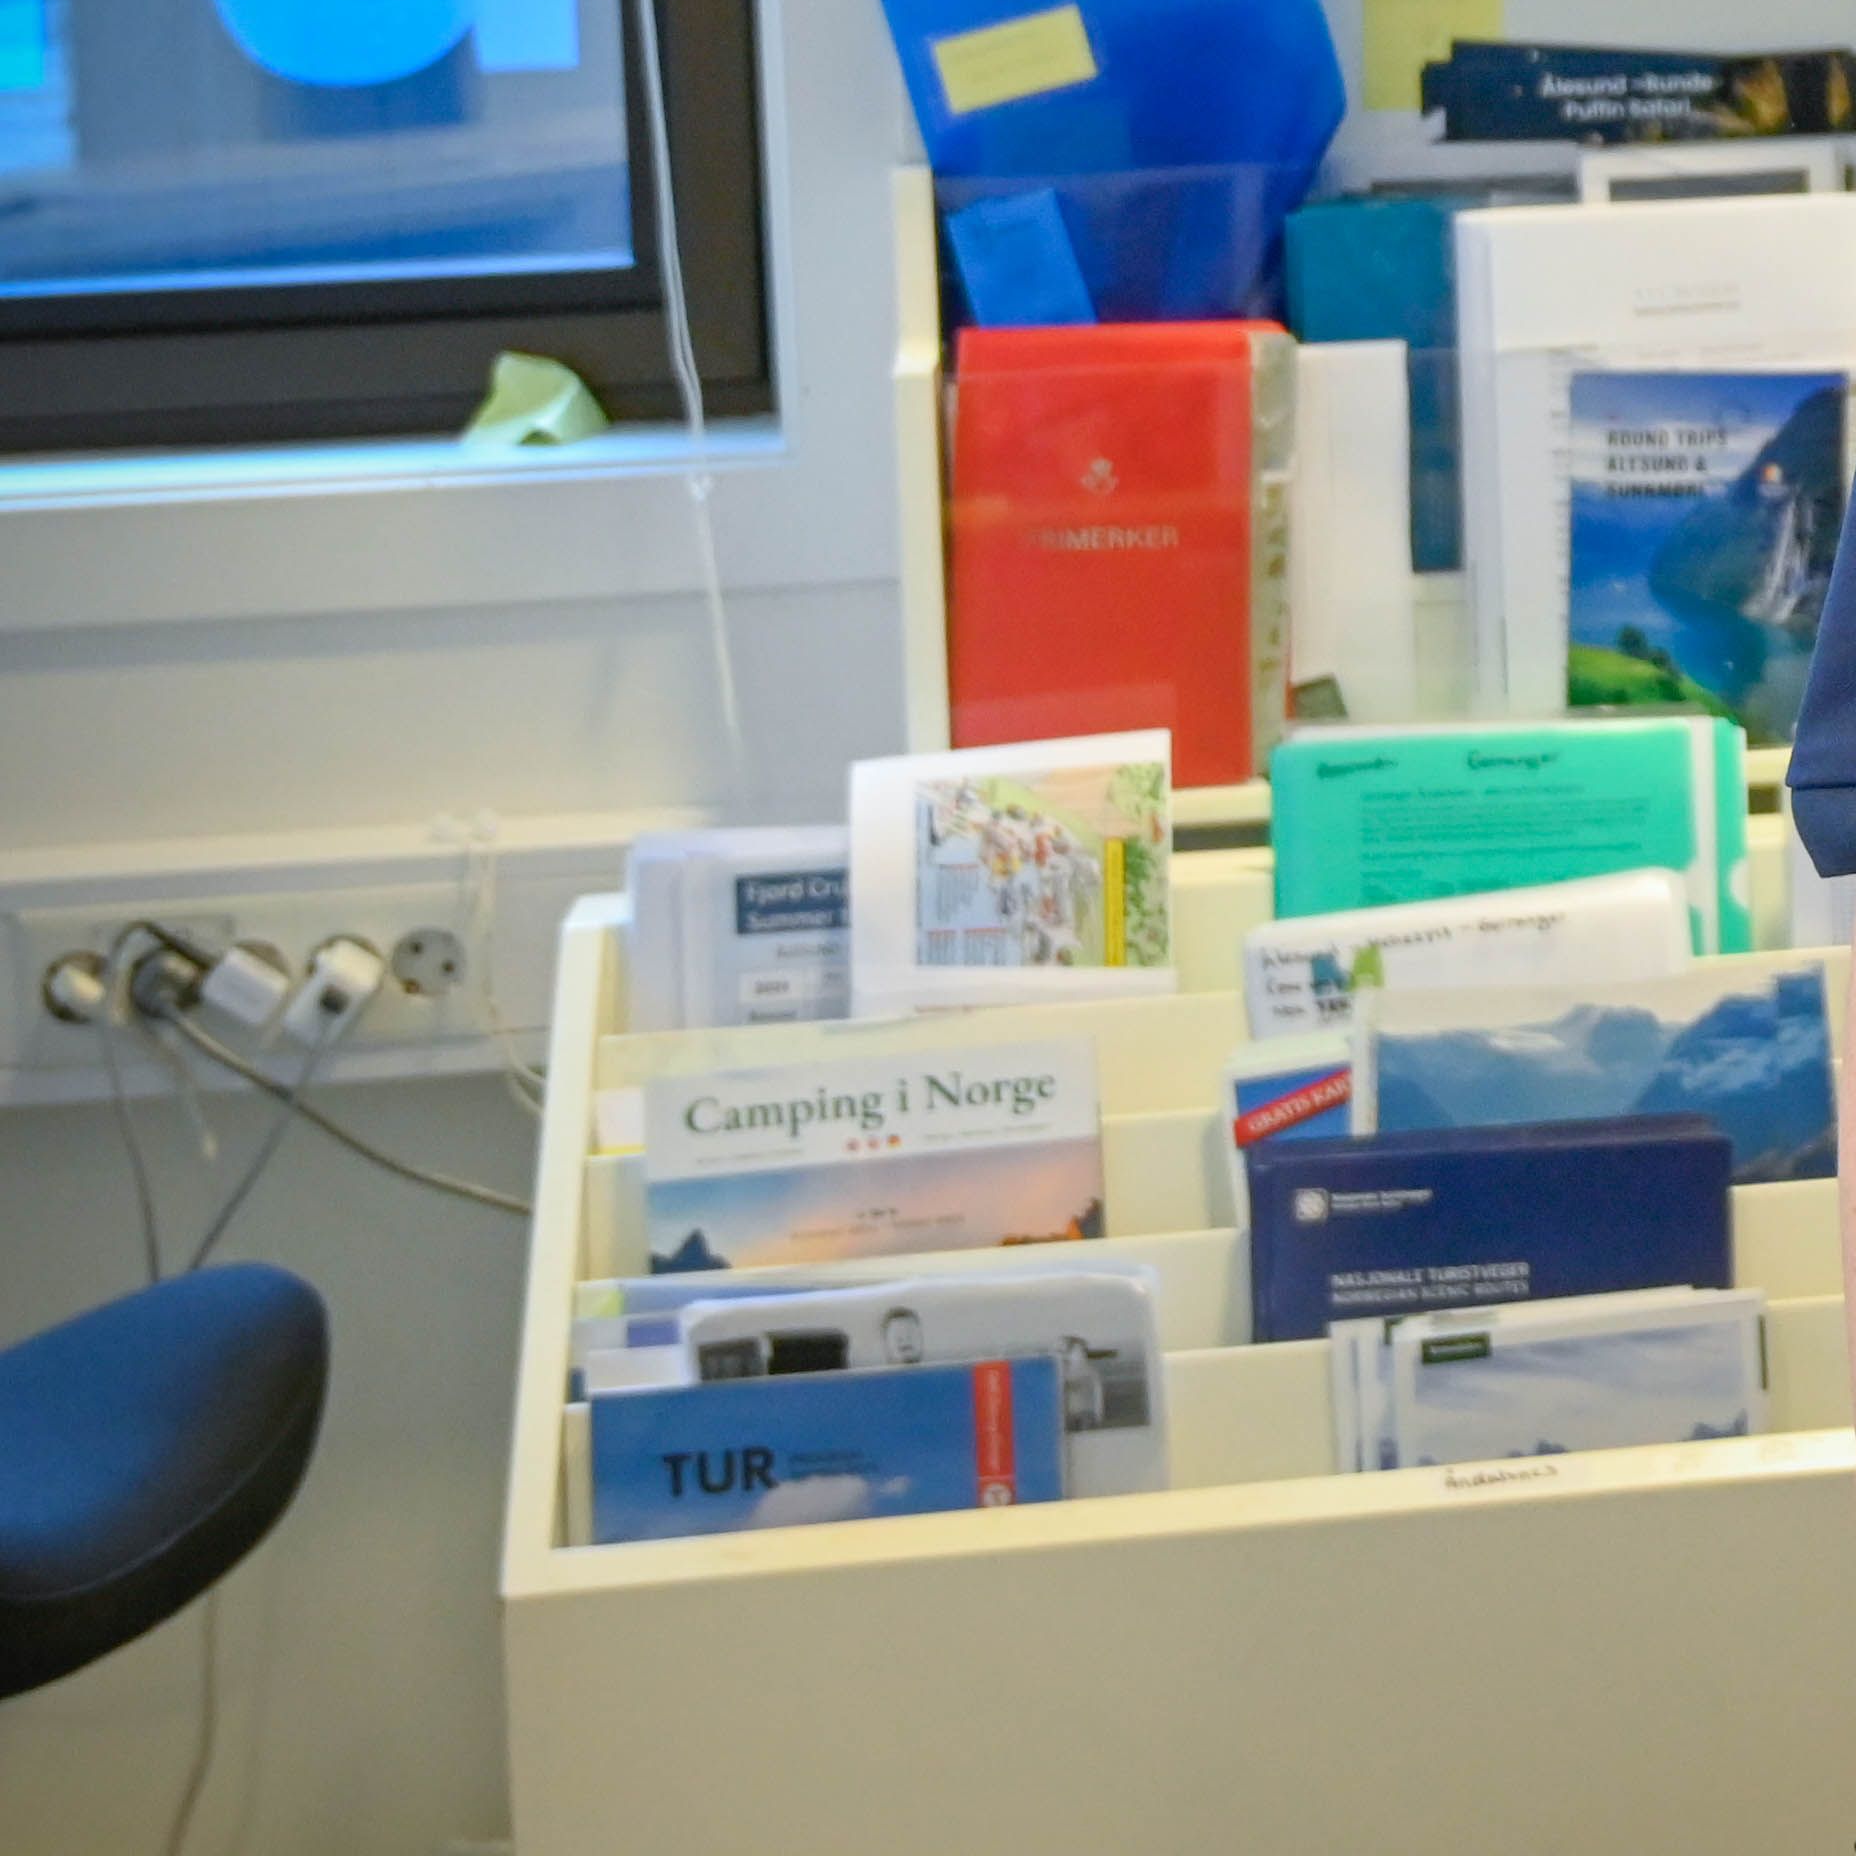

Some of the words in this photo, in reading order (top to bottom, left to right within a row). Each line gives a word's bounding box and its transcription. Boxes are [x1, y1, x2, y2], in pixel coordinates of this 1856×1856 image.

[1562, 97, 1626, 122] Puffin
[1607, 429, 1669, 448] ROUND
[1677, 428, 1729, 446] TRIPS
[684, 1084, 887, 1138] Camping
[896, 1075, 911, 1114] i
[921, 1068, 1056, 1122] Norge
[1248, 1092, 1312, 1134] GRATIS
[1330, 1269, 1422, 1288] NASJONALE
[1424, 1262, 1529, 1283] TURISTVEGER
[662, 1445, 780, 1500] TUR
